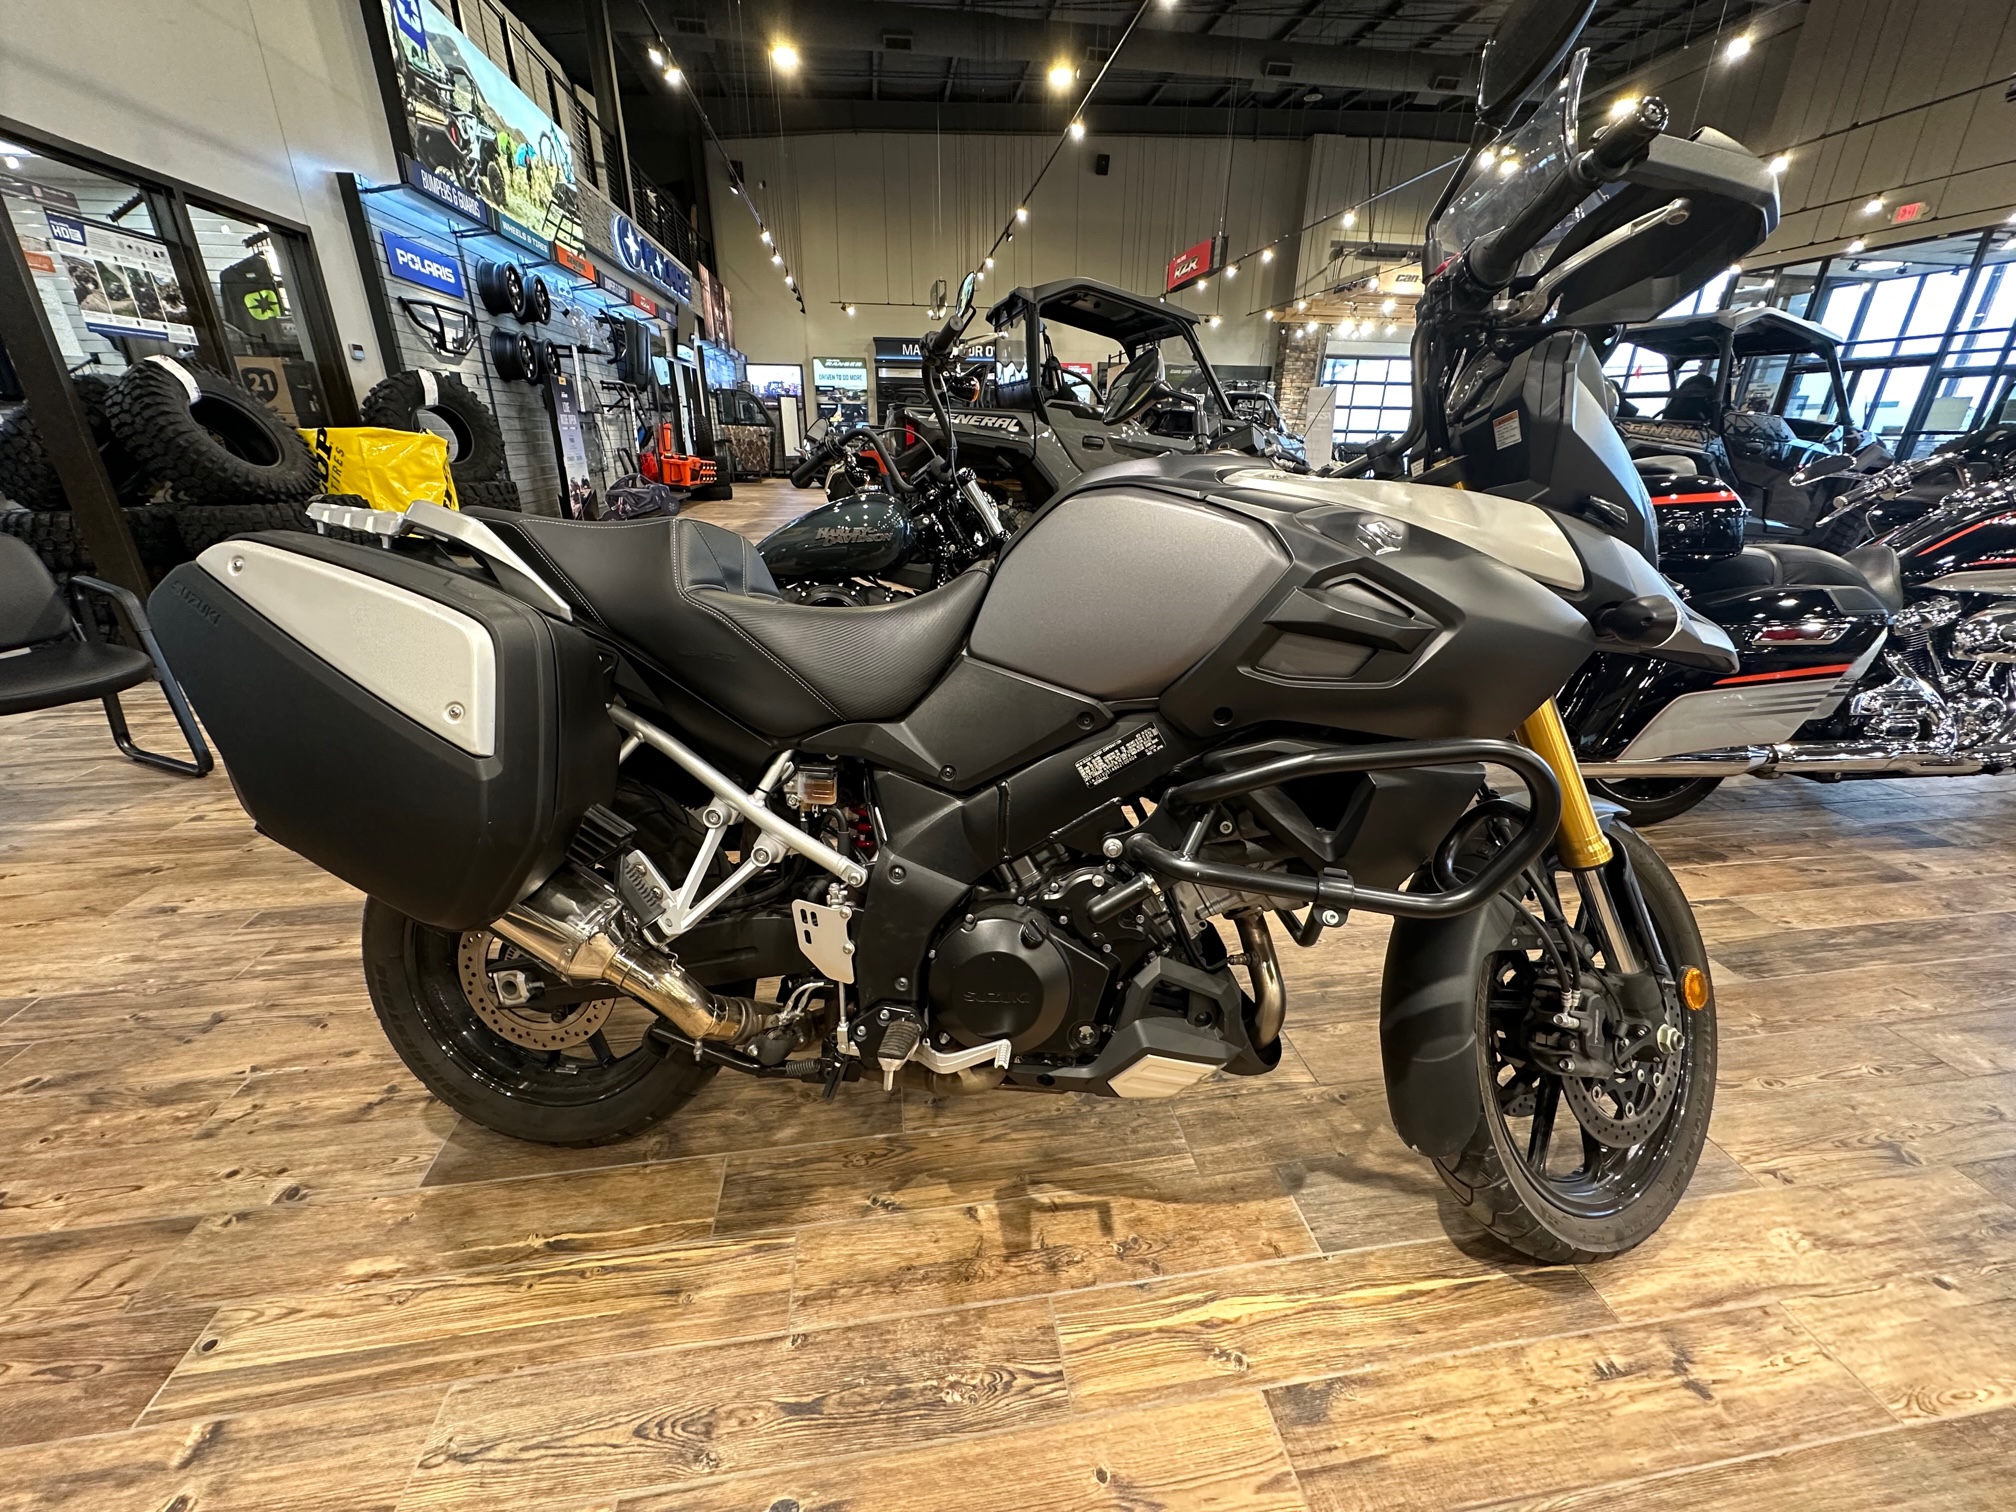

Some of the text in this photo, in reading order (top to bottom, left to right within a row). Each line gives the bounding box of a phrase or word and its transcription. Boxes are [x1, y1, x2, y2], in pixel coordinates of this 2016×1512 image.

[420, 168, 453, 203] BUMPERS
[457, 190, 481, 219] GUARDS
[51, 223, 70, 239] HD
[501, 219, 527, 241] WHEELS
[531, 236, 549, 254] TIRES
[395, 247, 456, 284] POLARIS
[1395, 273, 1422, 283] can-
[247, 372, 275, 392] 21
[1627, 422, 1700, 440] GENERAL
[331, 446, 345, 492] TIRES
[171, 580, 222, 628] SUZUKI
[963, 991, 1031, 1004] SUZUKI
